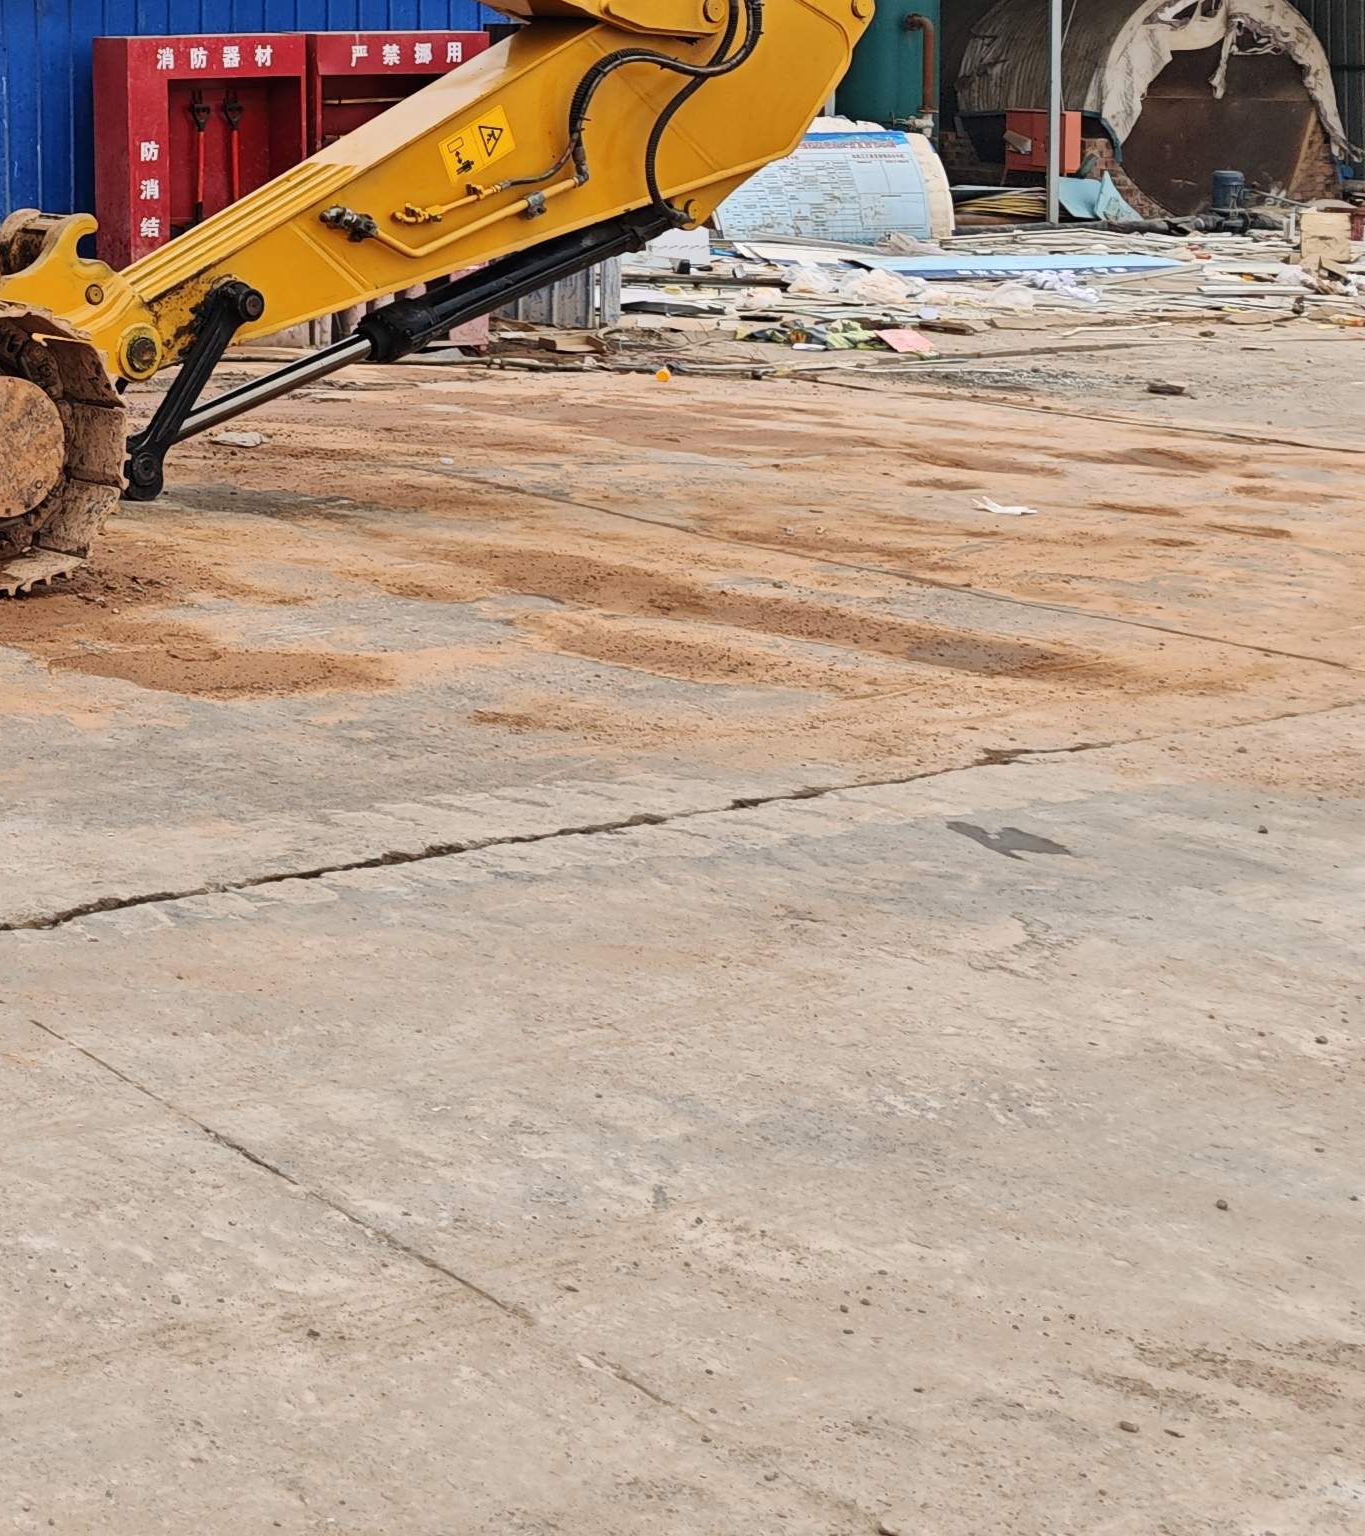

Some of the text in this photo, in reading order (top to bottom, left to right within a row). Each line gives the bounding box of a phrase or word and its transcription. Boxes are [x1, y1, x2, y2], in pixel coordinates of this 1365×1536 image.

[156, 44, 273, 70] 消防器材
[350, 41, 463, 67] 严禁挪用
